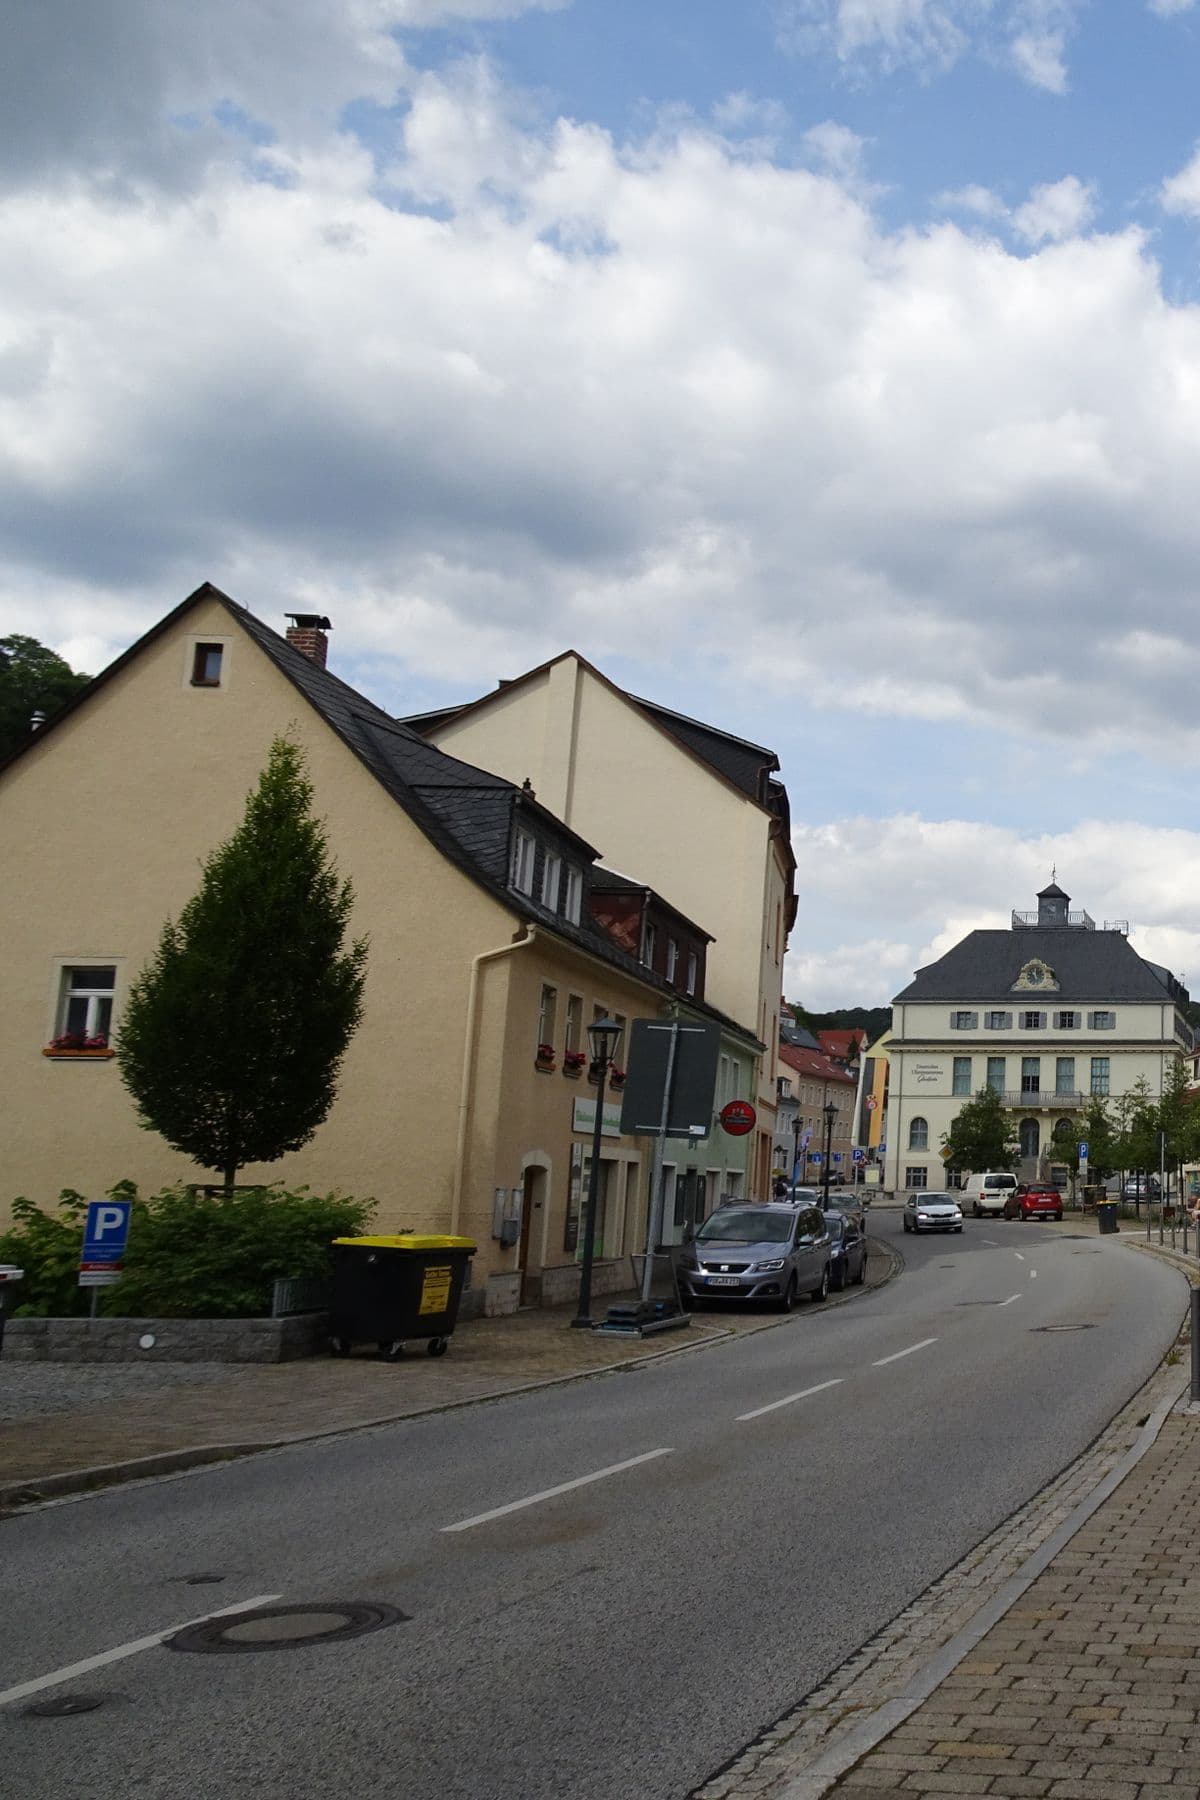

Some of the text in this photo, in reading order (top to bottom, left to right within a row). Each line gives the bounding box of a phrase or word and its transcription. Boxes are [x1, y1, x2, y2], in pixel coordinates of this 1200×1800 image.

[854, 1150, 862, 1160] P
[1080, 1144, 1087, 1157] P
[93, 1207, 125, 1241] P
